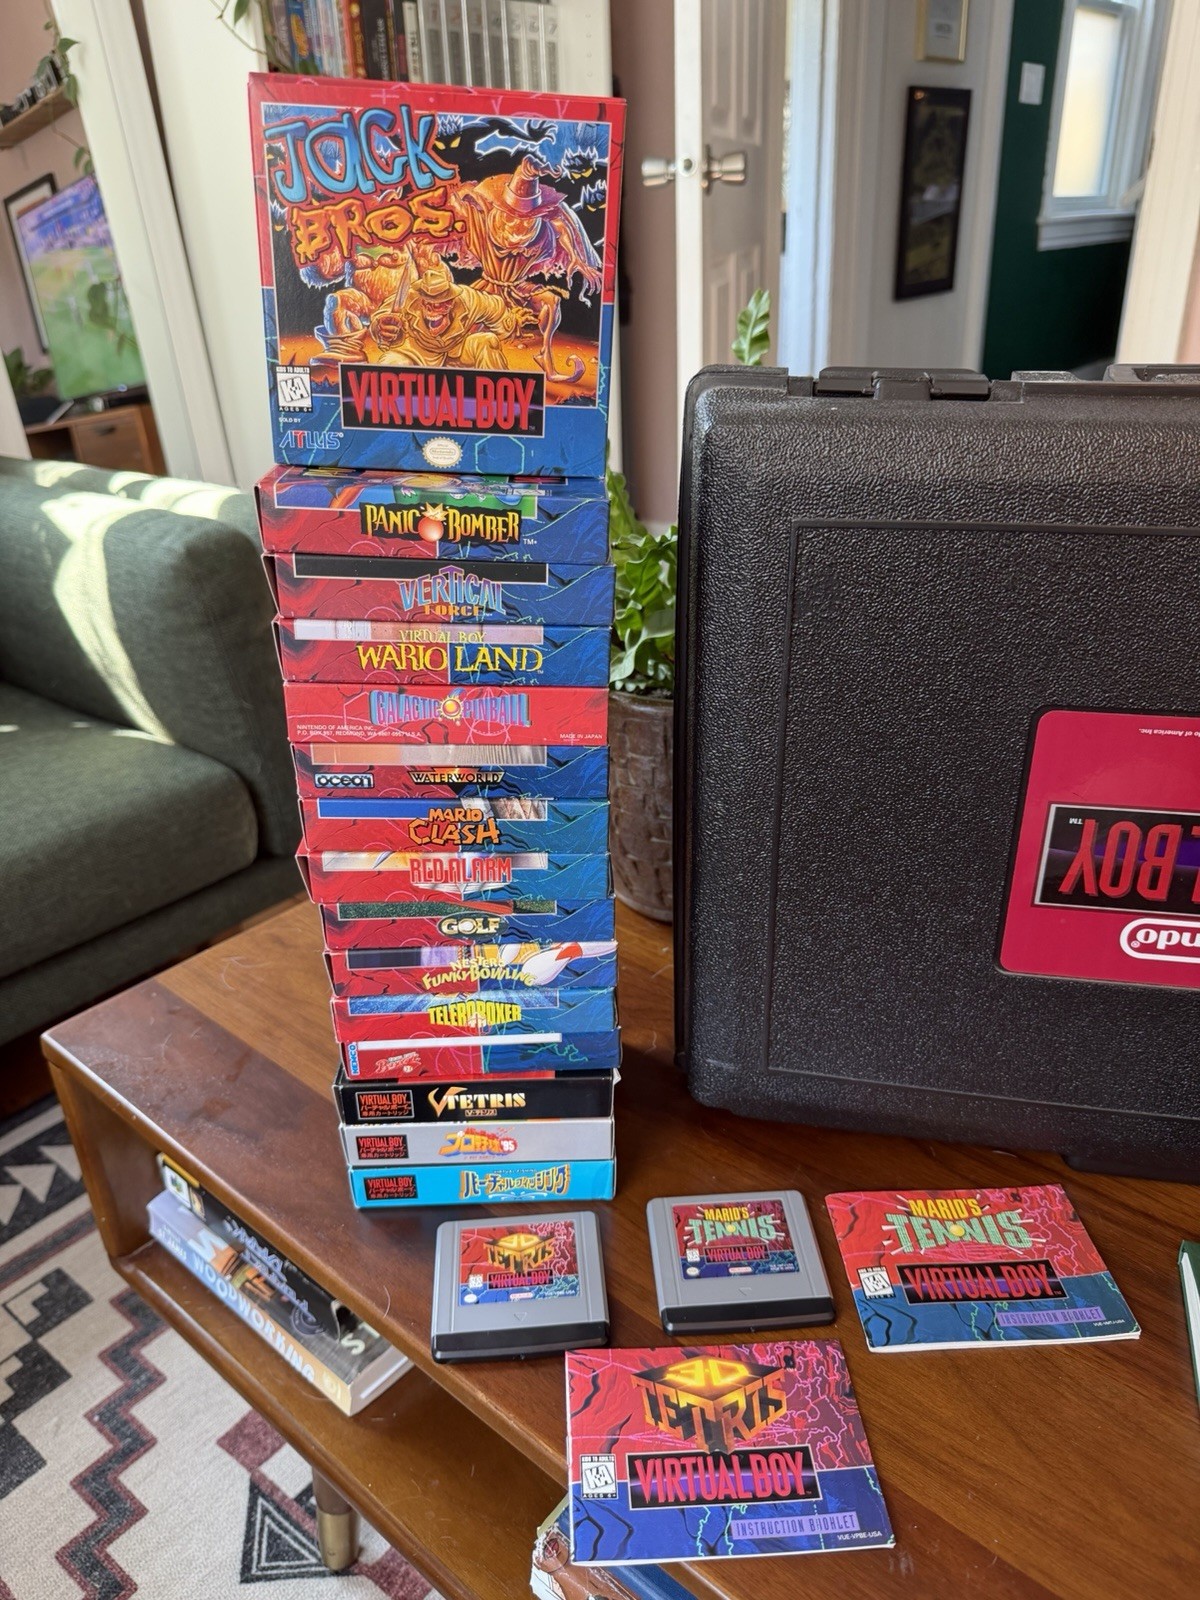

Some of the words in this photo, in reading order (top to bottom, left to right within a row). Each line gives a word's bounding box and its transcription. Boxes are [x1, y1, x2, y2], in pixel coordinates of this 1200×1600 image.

[264, 104, 457, 201] JACK
[347, 369, 473, 428] VIRTUAL
[476, 374, 538, 431] BOY
[365, 504, 420, 538] PANIC
[447, 508, 520, 543] BOMBER
[400, 565, 506, 616] VERTICAL
[423, 605, 480, 617] FORCE
[398, 628, 451, 644] VIRTUAL
[457, 631, 488, 644] BOY
[356, 644, 449, 671] WARIO
[454, 646, 544, 672] LAND
[370, 690, 441, 726] GALACTIC
[462, 693, 532, 727] PINBALL
[1153, 729, 1184, 737] America
[317, 775, 373, 787] ocean
[411, 773, 500, 783] WATERWORLD
[429, 808, 484, 823] MARIO
[408, 817, 500, 846] CLASH
[409, 857, 445, 883] RED
[447, 858, 512, 883] ALARM
[1057, 818, 1183, 902] BOY
[441, 917, 501, 934] GOLF
[422, 970, 471, 991] FUNKY
[469, 966, 538, 987] BOWLING
[360, 1094, 391, 1105] VIRTUAL
[392, 1093, 407, 1104] BOY
[358, 1137, 388, 1148] VIRTUAL
[388, 1136, 403, 1147] BOY
[368, 1177, 398, 1188] VIRTUAL
[398, 1176, 413, 1187] BOY
[704, 1206, 750, 1221] MARIO'S
[908, 1197, 984, 1221] MARIO'S
[688, 1214, 777, 1245] TENNIS
[885, 1210, 1035, 1254] TENNIS
[483, 1238, 556, 1273] TETRIS
[706, 1247, 747, 1262] VIRTUAL
[748, 1245, 766, 1260] BOY
[490, 1273, 530, 1288] VIRTUAL
[530, 1270, 551, 1286] BOY
[903, 1268, 1008, 1300] VIRTUAL
[1003, 1264, 1054, 1298] BOY
[1000, 1312, 1060, 1325] INSTRUCTION
[631, 1368, 788, 1454] TETRIS
[634, 1455, 754, 1504] VIRTUAL
[750, 1451, 806, 1498] BOY
[736, 1519, 805, 1537] INSTRUCTION
